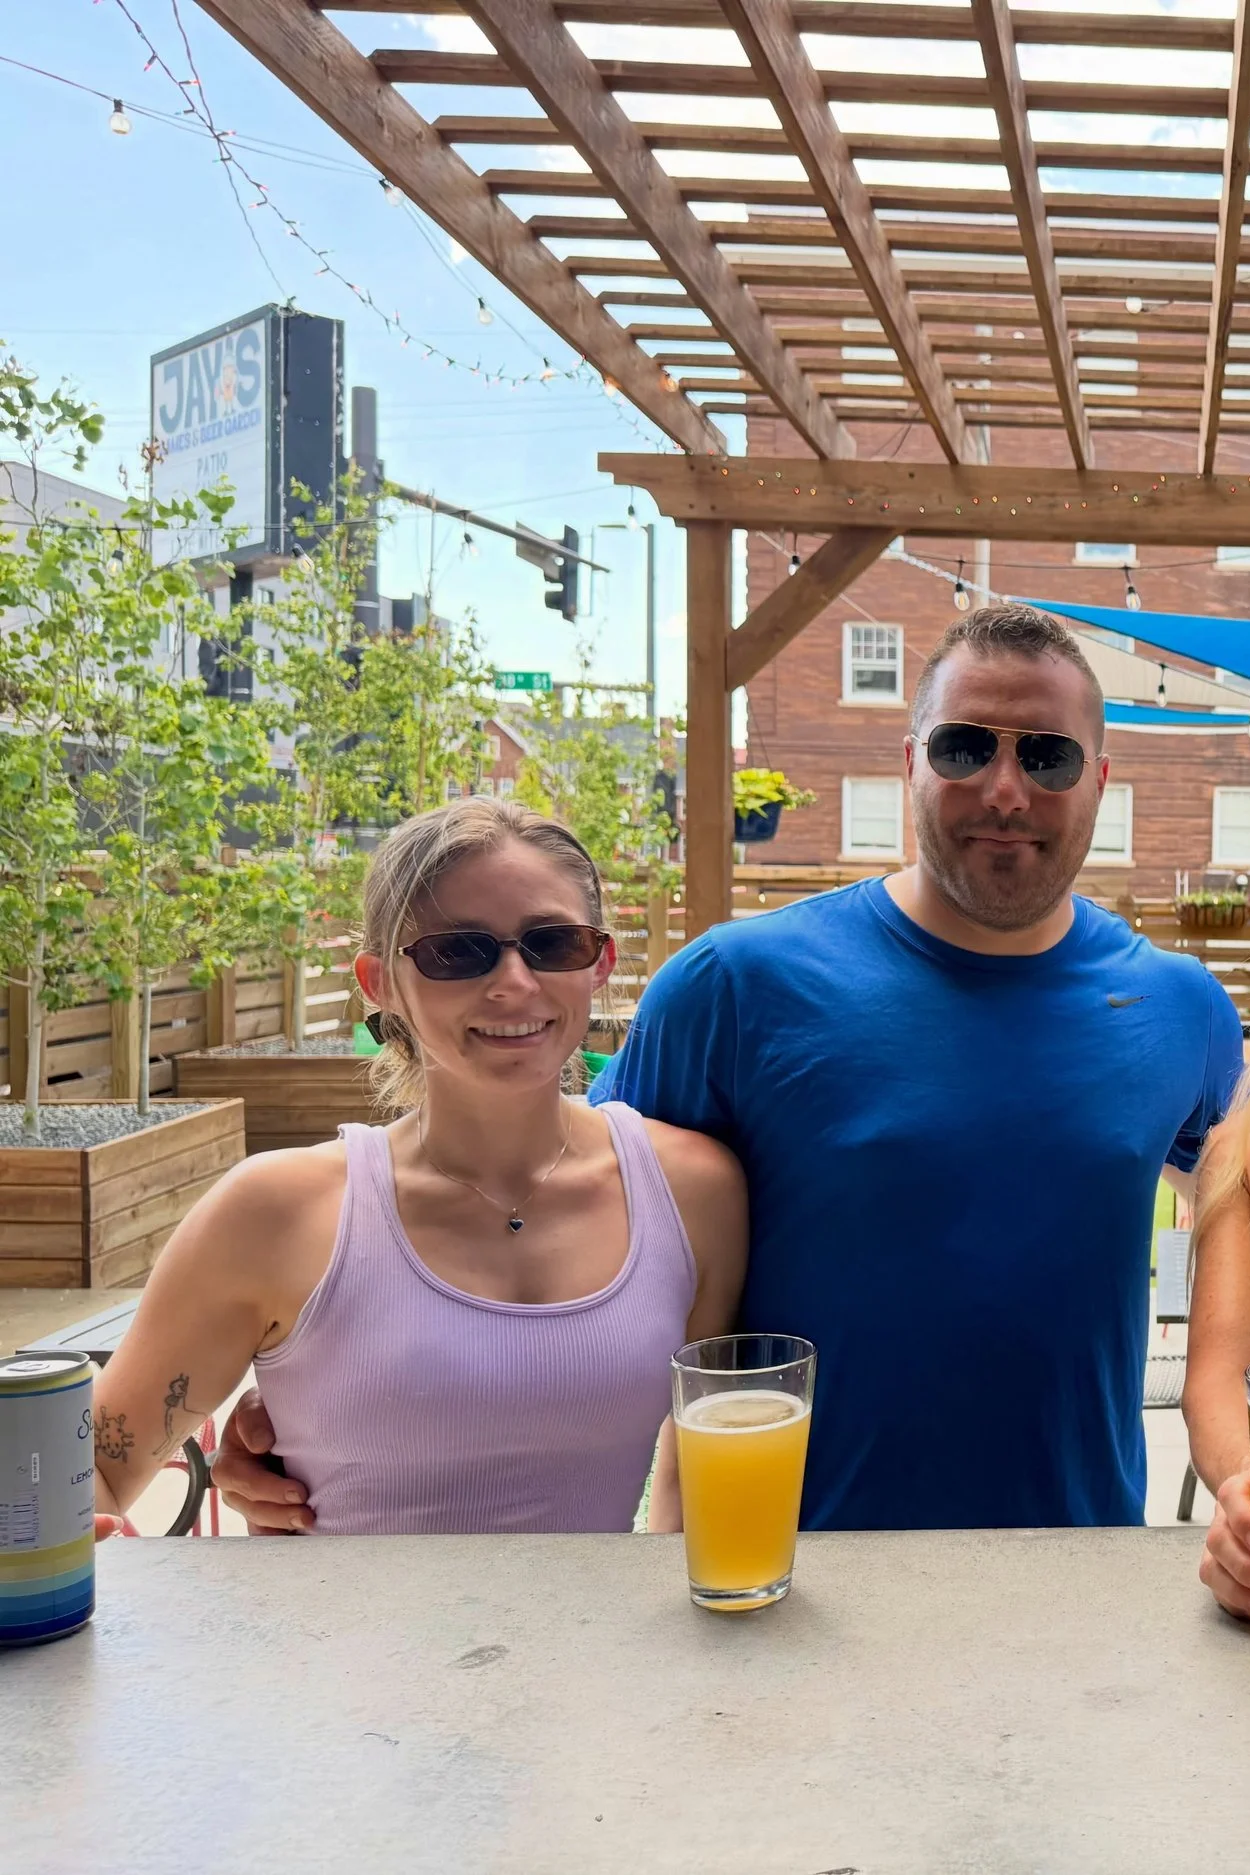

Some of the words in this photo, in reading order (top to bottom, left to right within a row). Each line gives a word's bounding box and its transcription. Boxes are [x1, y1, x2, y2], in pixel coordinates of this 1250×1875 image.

[159, 328, 262, 434] JAY'S
[197, 450, 228, 479] PATIO
[71, 1467, 94, 1486] LEMO
